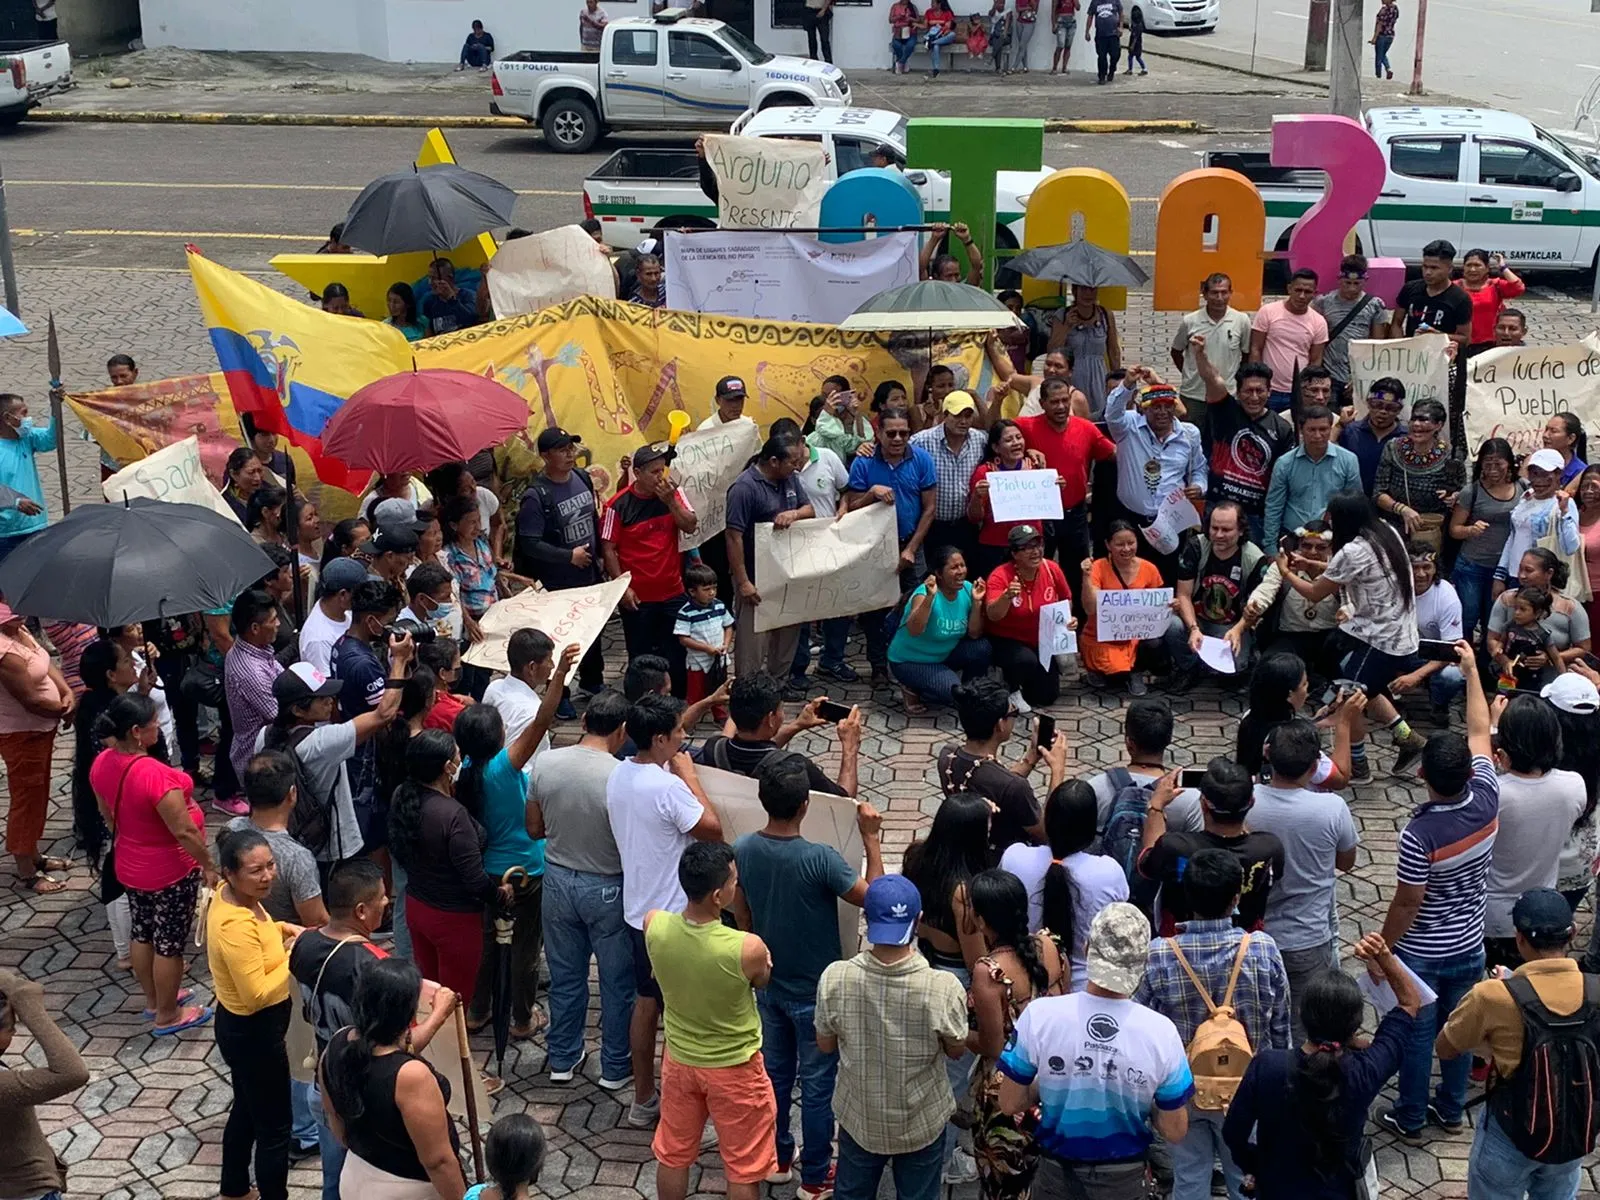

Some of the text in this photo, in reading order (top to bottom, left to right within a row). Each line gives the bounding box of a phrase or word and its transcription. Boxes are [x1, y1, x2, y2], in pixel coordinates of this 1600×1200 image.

[522, 63, 559, 71] POLICIA
[713, 145, 811, 195] Arajuno
[1510, 250, 1562, 259] SANTACLARA
[1362, 343, 1430, 374] JATUN
[1472, 361, 1496, 383] La
[1512, 355, 1565, 380] lucha
[1494, 386, 1569, 416] Pueblo
[779, 576, 862, 617] Libre
[1101, 609, 1116, 624] Su
